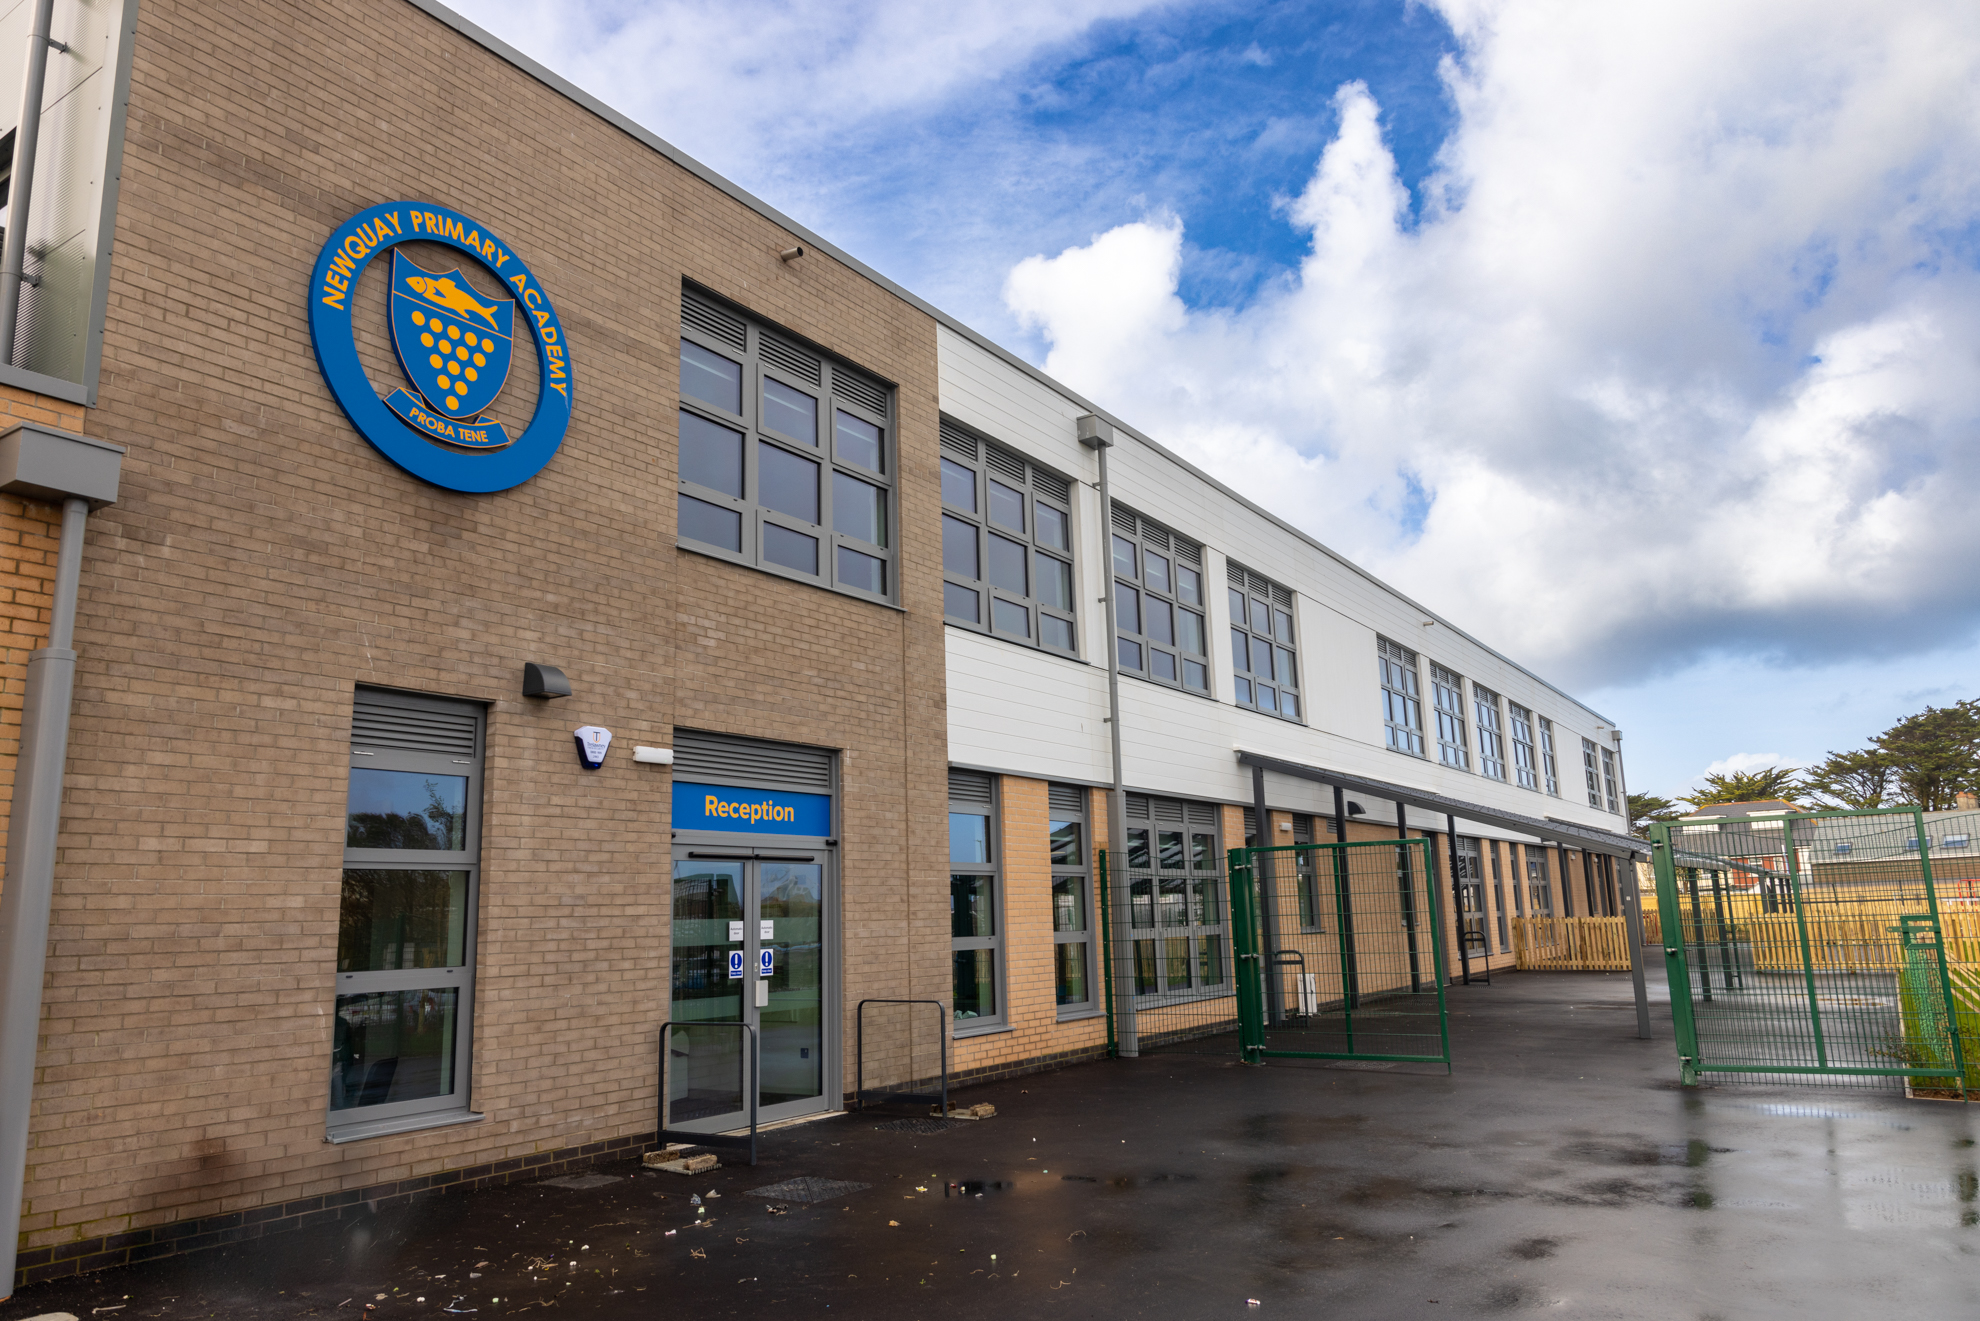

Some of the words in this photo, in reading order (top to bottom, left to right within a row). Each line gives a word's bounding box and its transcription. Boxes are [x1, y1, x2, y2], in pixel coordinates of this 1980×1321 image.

[322, 211, 403, 310] NEWQUAY
[410, 210, 510, 268] PRIMARY
[509, 274, 567, 397] ACADEMY
[409, 407, 455, 438] PROBA
[458, 428, 488, 442] TENE
[705, 795, 794, 824] Reception
